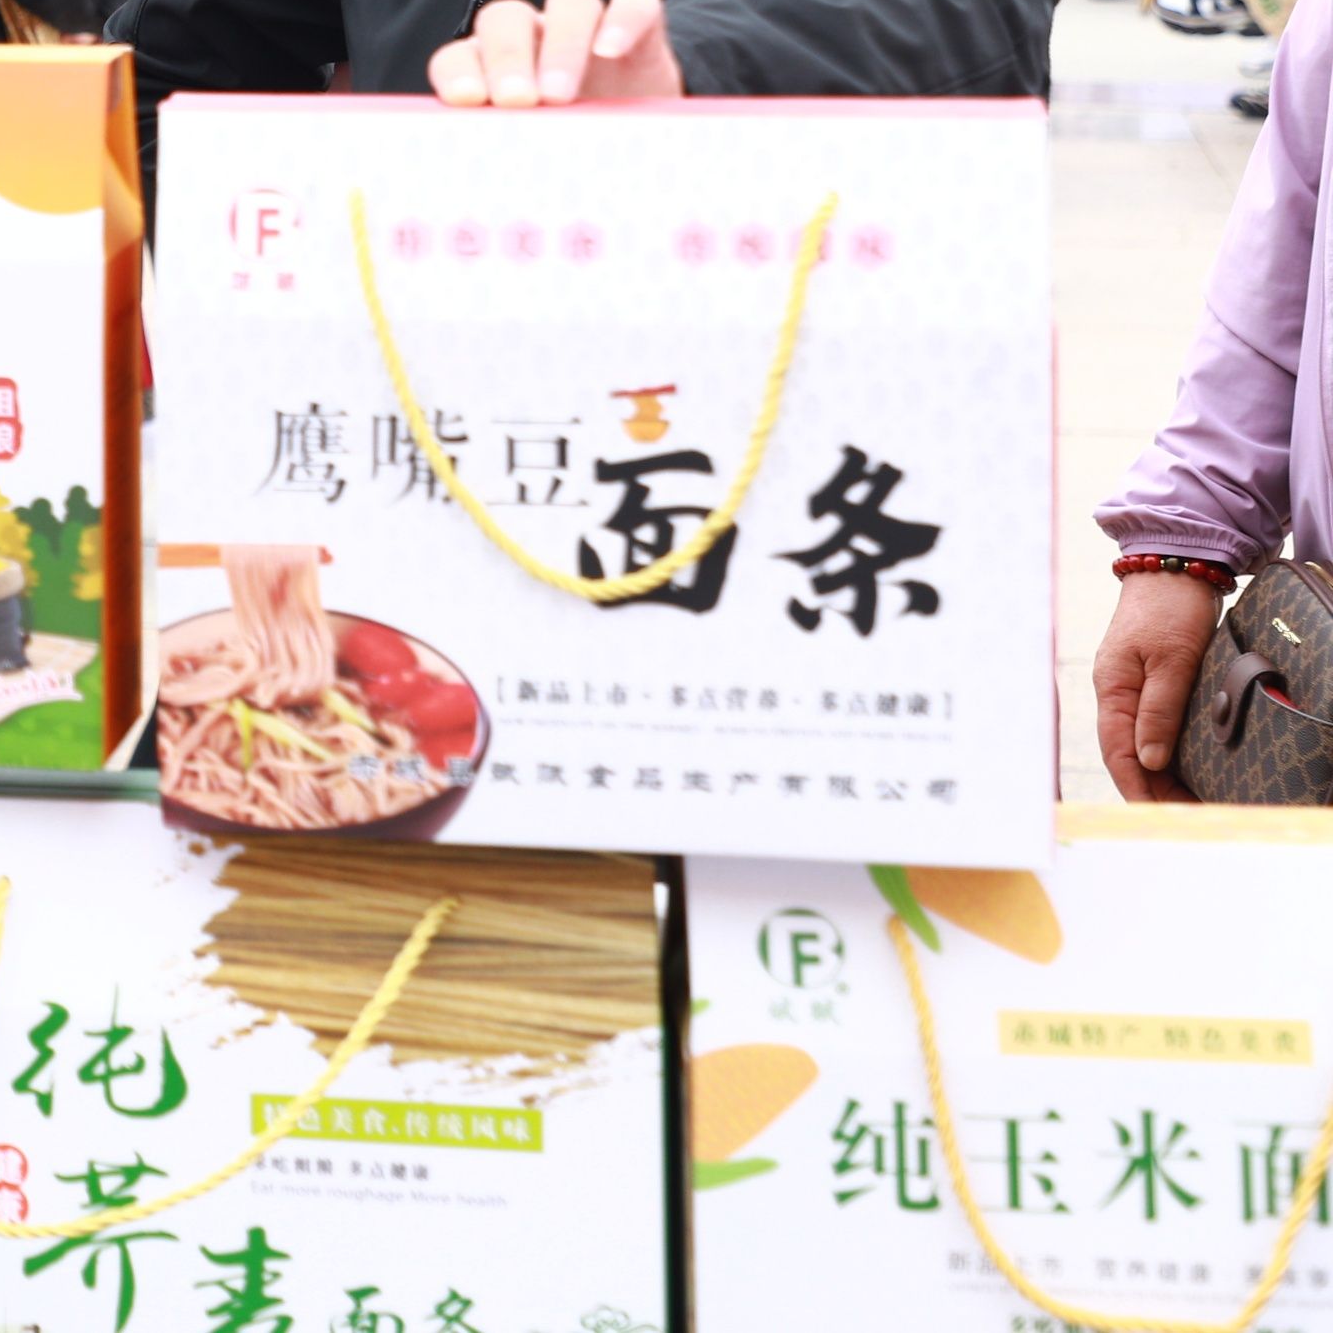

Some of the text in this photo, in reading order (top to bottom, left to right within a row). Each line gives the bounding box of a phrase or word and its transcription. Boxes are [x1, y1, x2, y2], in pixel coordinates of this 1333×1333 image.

[259, 403, 943, 638] 鹰嘴豆 面条
